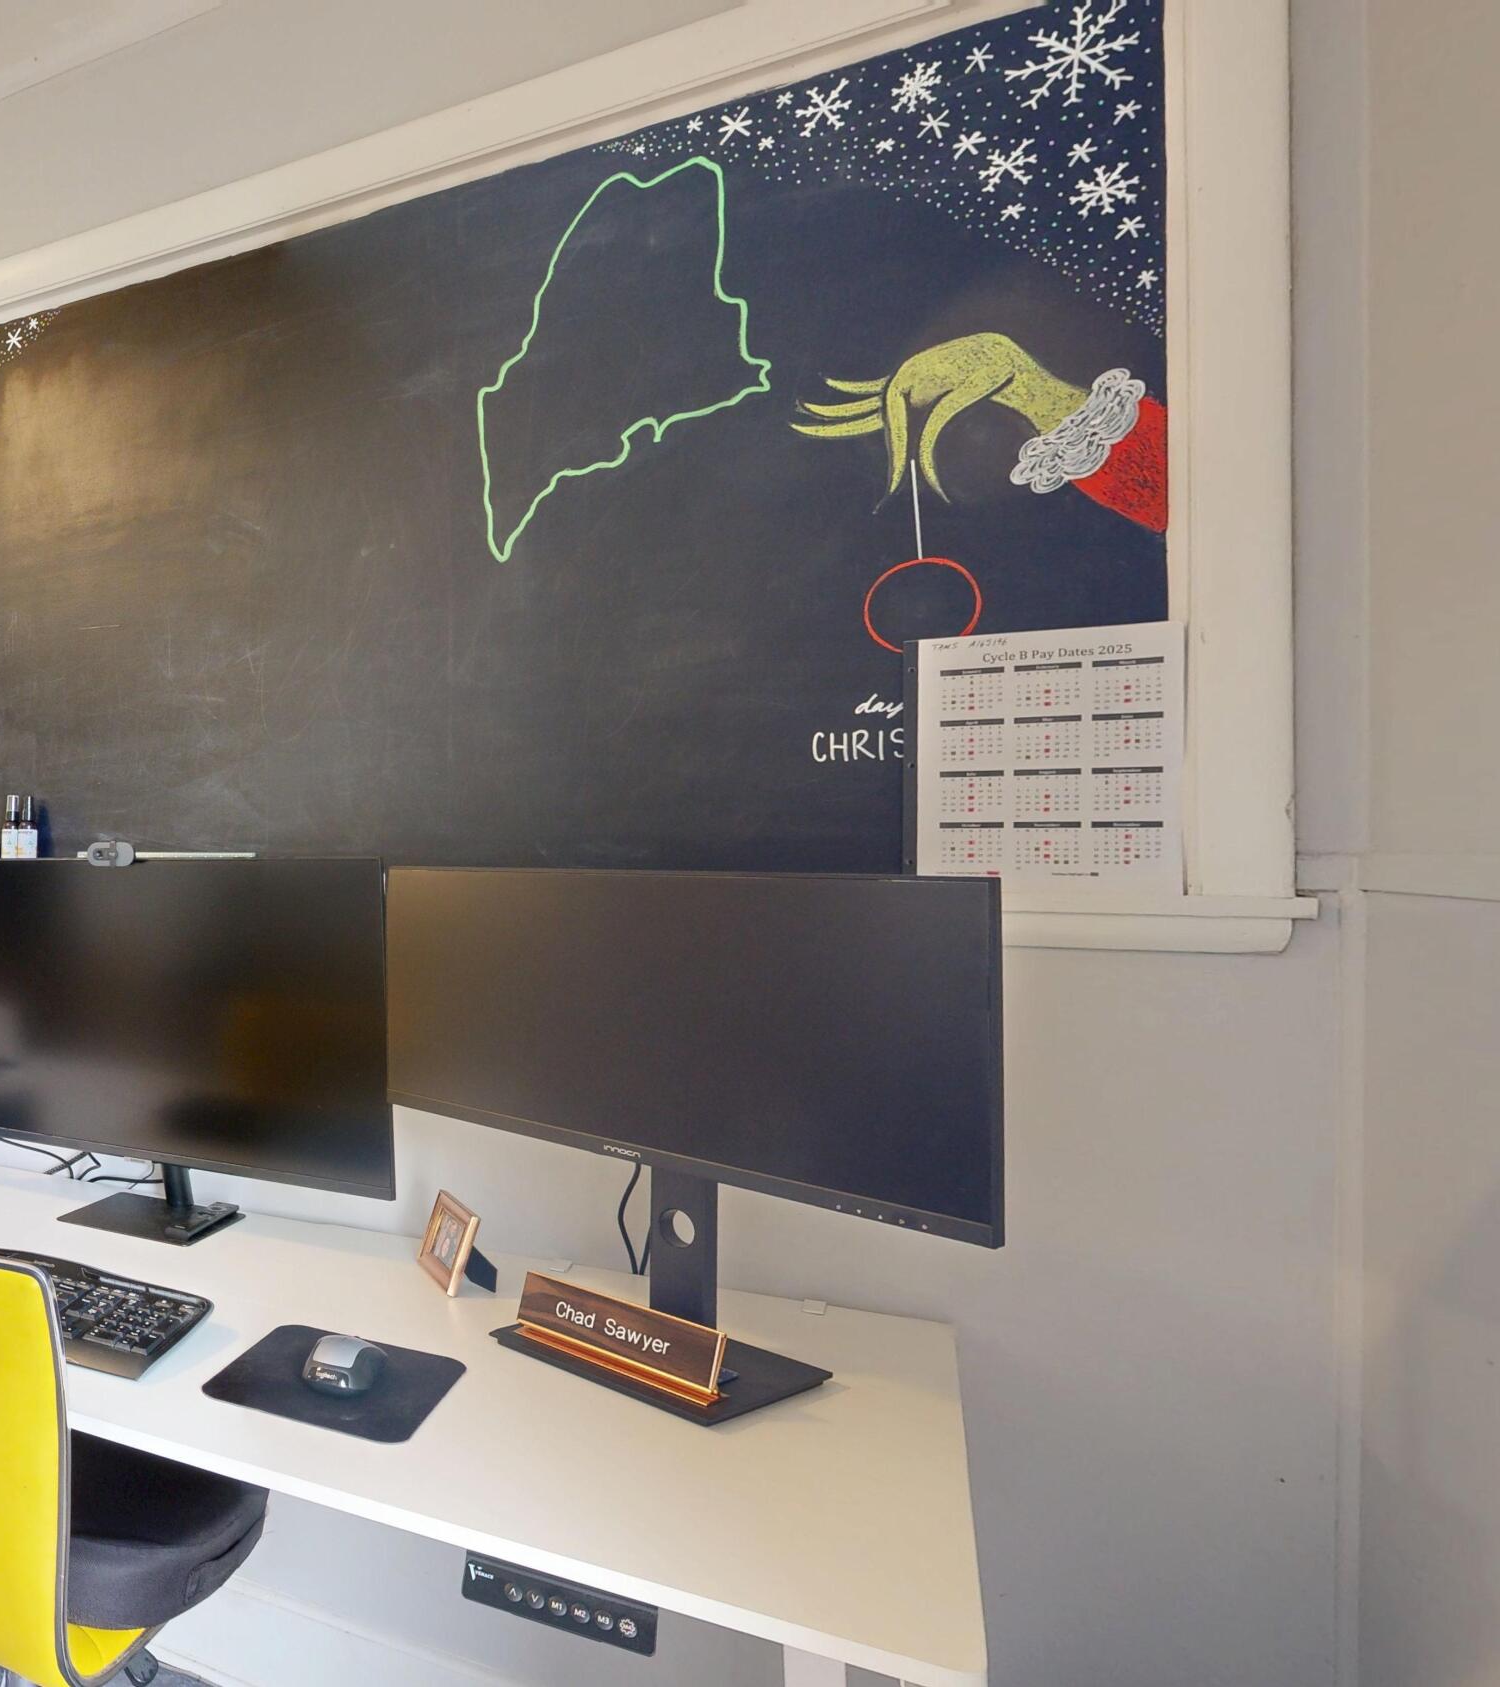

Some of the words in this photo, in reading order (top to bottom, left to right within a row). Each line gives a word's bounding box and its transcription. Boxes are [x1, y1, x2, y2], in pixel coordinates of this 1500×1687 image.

[982, 651, 1016, 664] Cycle
[1019, 650, 1028, 660] B
[1031, 649, 1055, 661] Pay
[1058, 647, 1095, 658] Dates
[1097, 643, 1133, 655] 2025
[812, 728, 904, 762] CHRIS
[555, 1301, 597, 1328] Chad
[603, 1318, 671, 1355] Sawyer
[551, 1601, 563, 1611] M1
[574, 1608, 586, 1618] M2
[597, 1615, 610, 1625] M3
